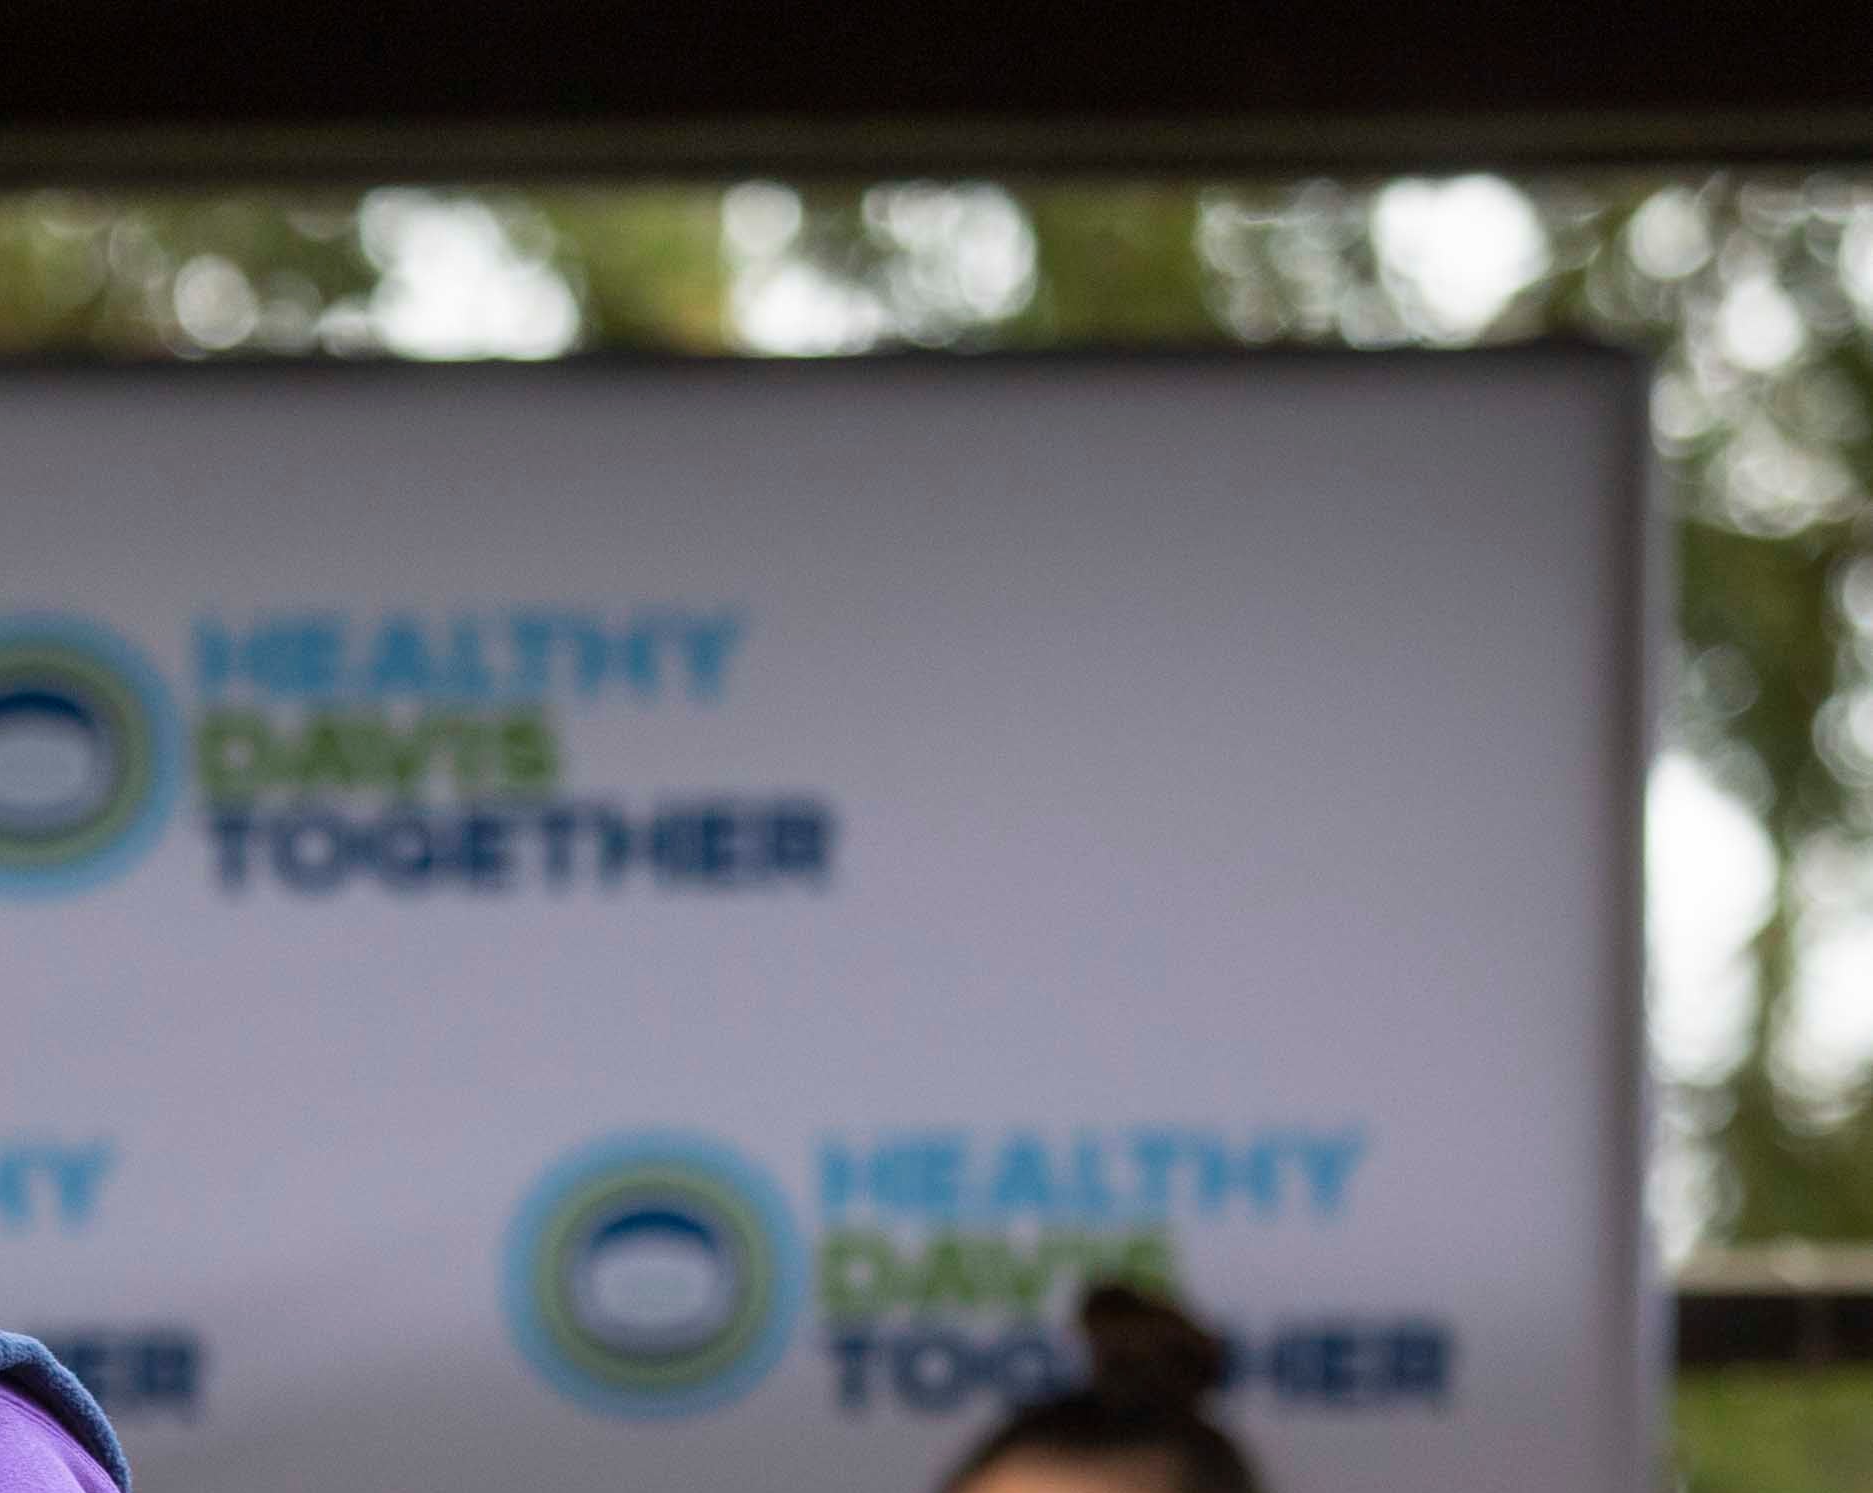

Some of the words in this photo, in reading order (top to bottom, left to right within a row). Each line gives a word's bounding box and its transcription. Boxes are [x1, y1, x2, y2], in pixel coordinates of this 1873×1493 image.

[192, 616, 742, 705] HEALTHY
[192, 706, 558, 793] DAVIS
[205, 802, 834, 896] TOGETHER
[815, 1130, 1363, 1221] HEALTHY
[829, 1323, 1450, 1412] TOGHER
